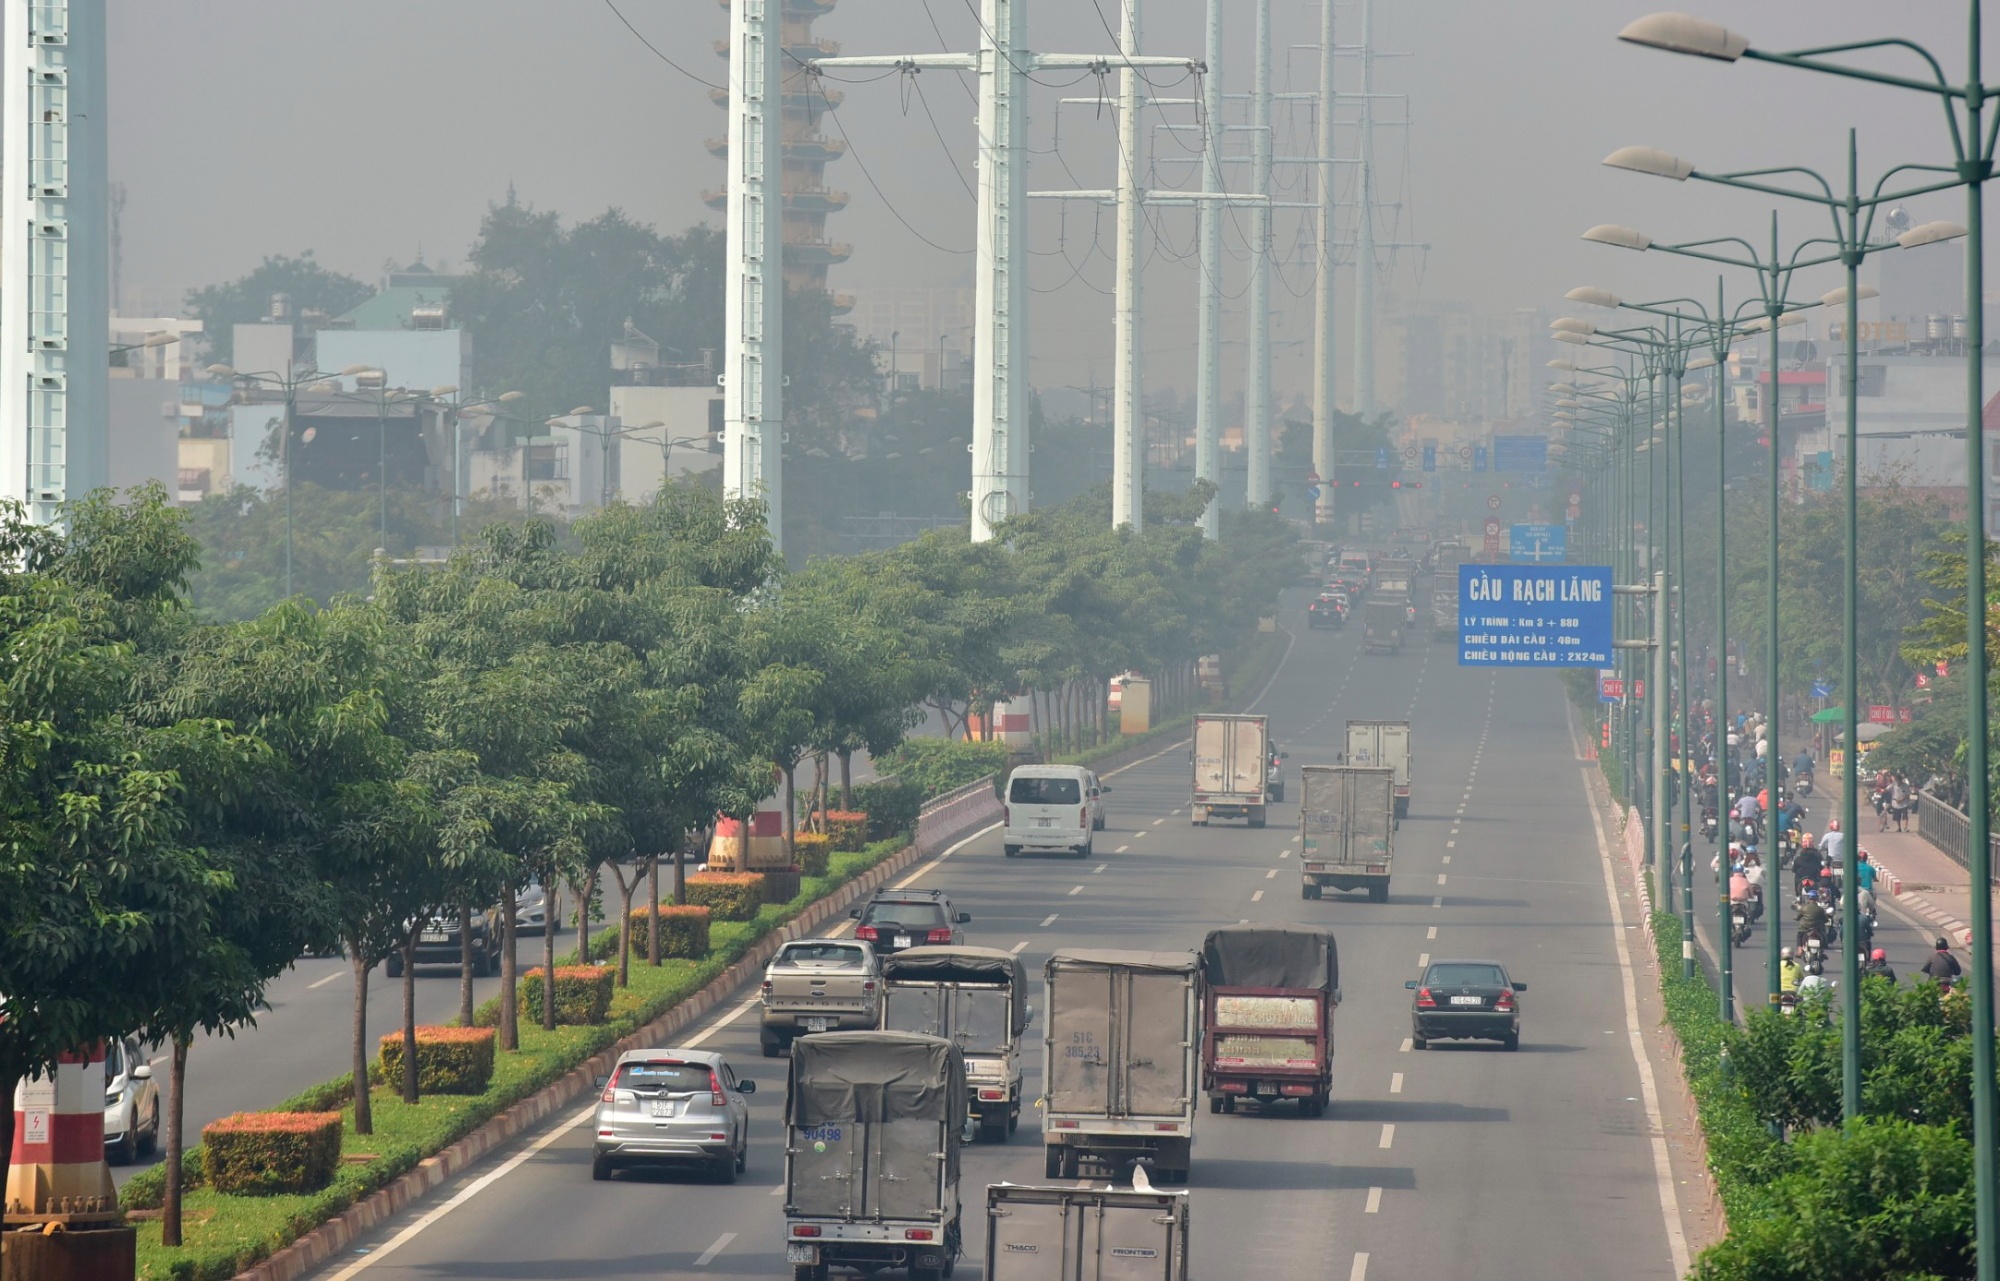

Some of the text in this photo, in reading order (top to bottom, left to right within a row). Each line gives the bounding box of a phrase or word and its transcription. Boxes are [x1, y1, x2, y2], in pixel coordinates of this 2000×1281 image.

[1469, 570, 1602, 606] CẦU RẠCH LĂNG
[1464, 615, 1477, 627] LÝ
[1481, 616, 1509, 627] TRÌNH
[1519, 618, 1534, 627] Km
[1536, 618, 1543, 627] 3
[1547, 619, 1556, 627] +
[1560, 618, 1579, 627] 880
[1465, 632, 1497, 645] CHIỀU
[1501, 634, 1520, 644] DÀI
[1523, 633, 1546, 645] CẦU
[1464, 648, 1497, 661] CHIỀU
[1501, 650, 1530, 663] RỘNG
[1533, 649, 1556, 661] CẦU
[1567, 652, 1605, 661] 2X24m
[1073, 1031, 1093, 1044] 51C
[1112, 1248, 1156, 1256] FRONTIER
